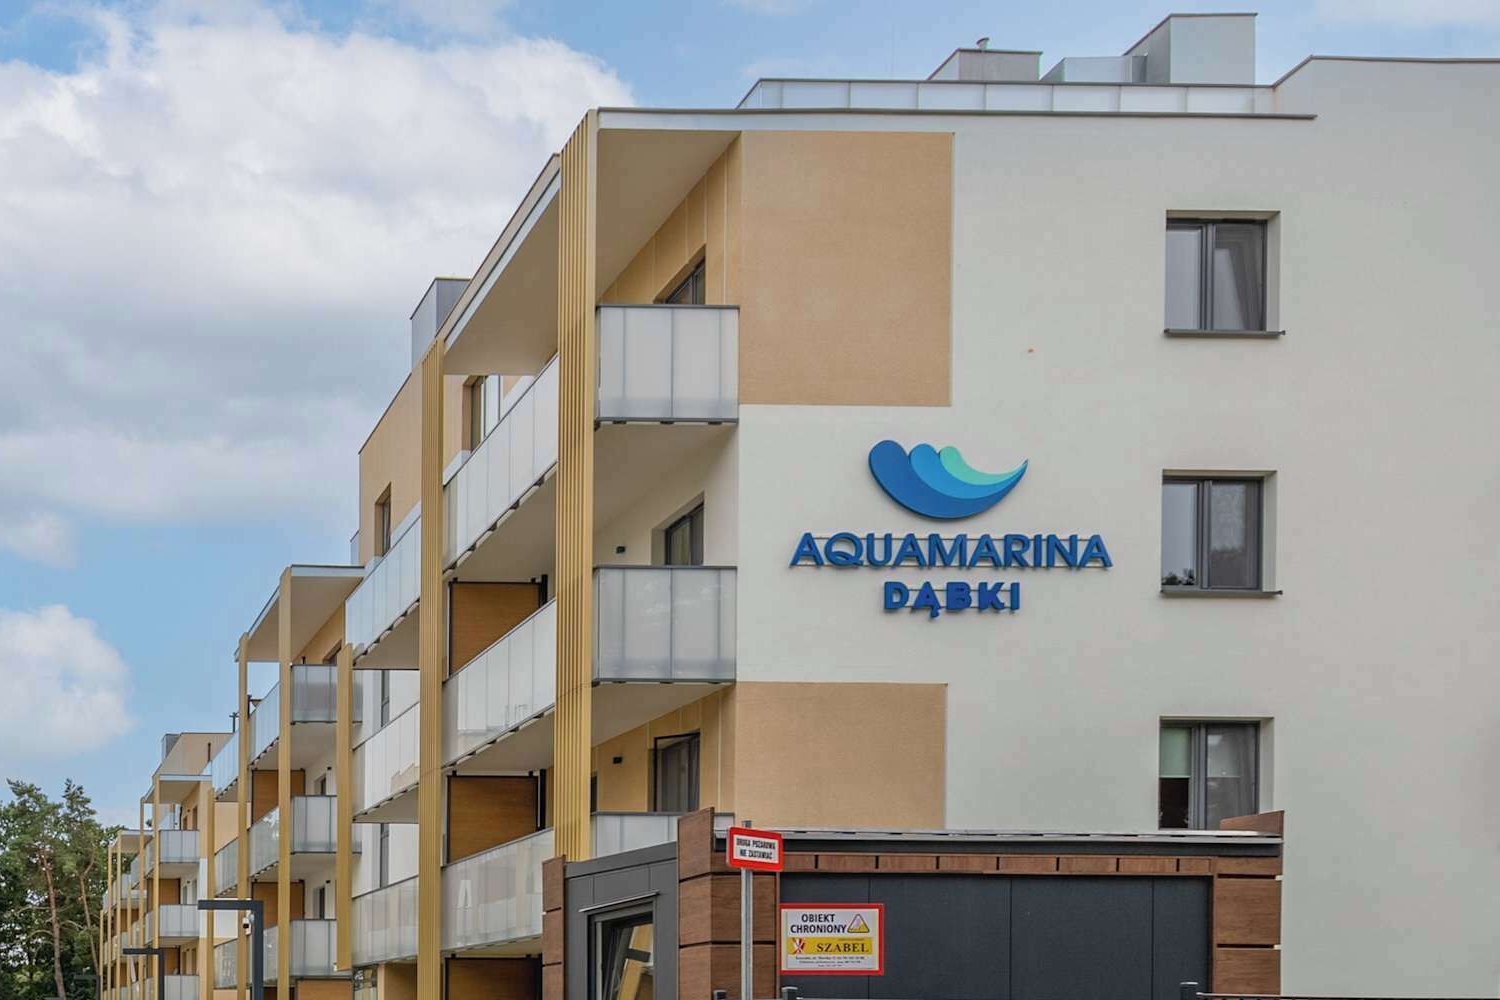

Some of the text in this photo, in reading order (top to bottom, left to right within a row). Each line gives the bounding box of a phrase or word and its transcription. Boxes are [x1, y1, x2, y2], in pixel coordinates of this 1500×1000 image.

[790, 532, 1113, 568] AQUAMARINA
[883, 581, 1020, 618] DĄBKI
[801, 913, 836, 923] OBIEKT
[790, 924, 847, 934] CHRONIONY
[817, 942, 869, 953] SZABEL
